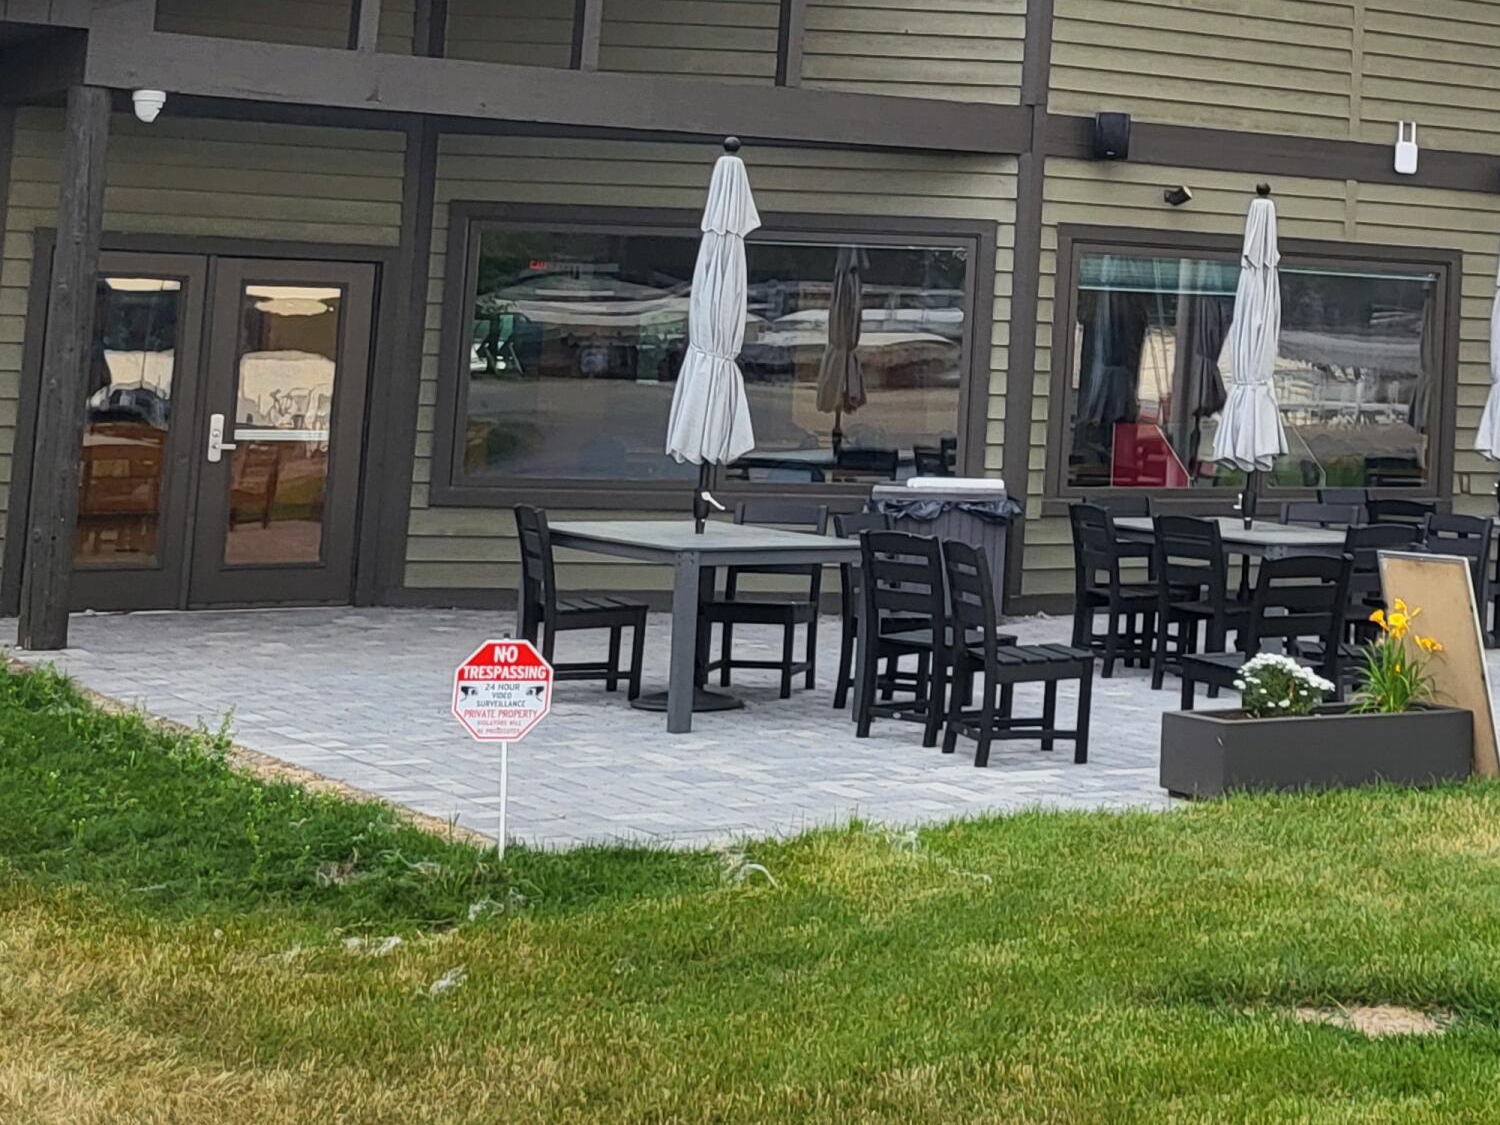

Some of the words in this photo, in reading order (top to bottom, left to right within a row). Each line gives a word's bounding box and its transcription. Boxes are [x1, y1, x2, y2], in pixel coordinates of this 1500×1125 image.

[493, 645, 519, 663] NO
[463, 665, 547, 679] TRESPASSING
[484, 683, 496, 691] 24
[498, 683, 520, 691] HOUR
[491, 692, 512, 700] VIDEO
[476, 700, 526, 708] SURVEILLANCE
[464, 709, 495, 718] PRIVATE
[498, 709, 538, 718] PROPERTY
